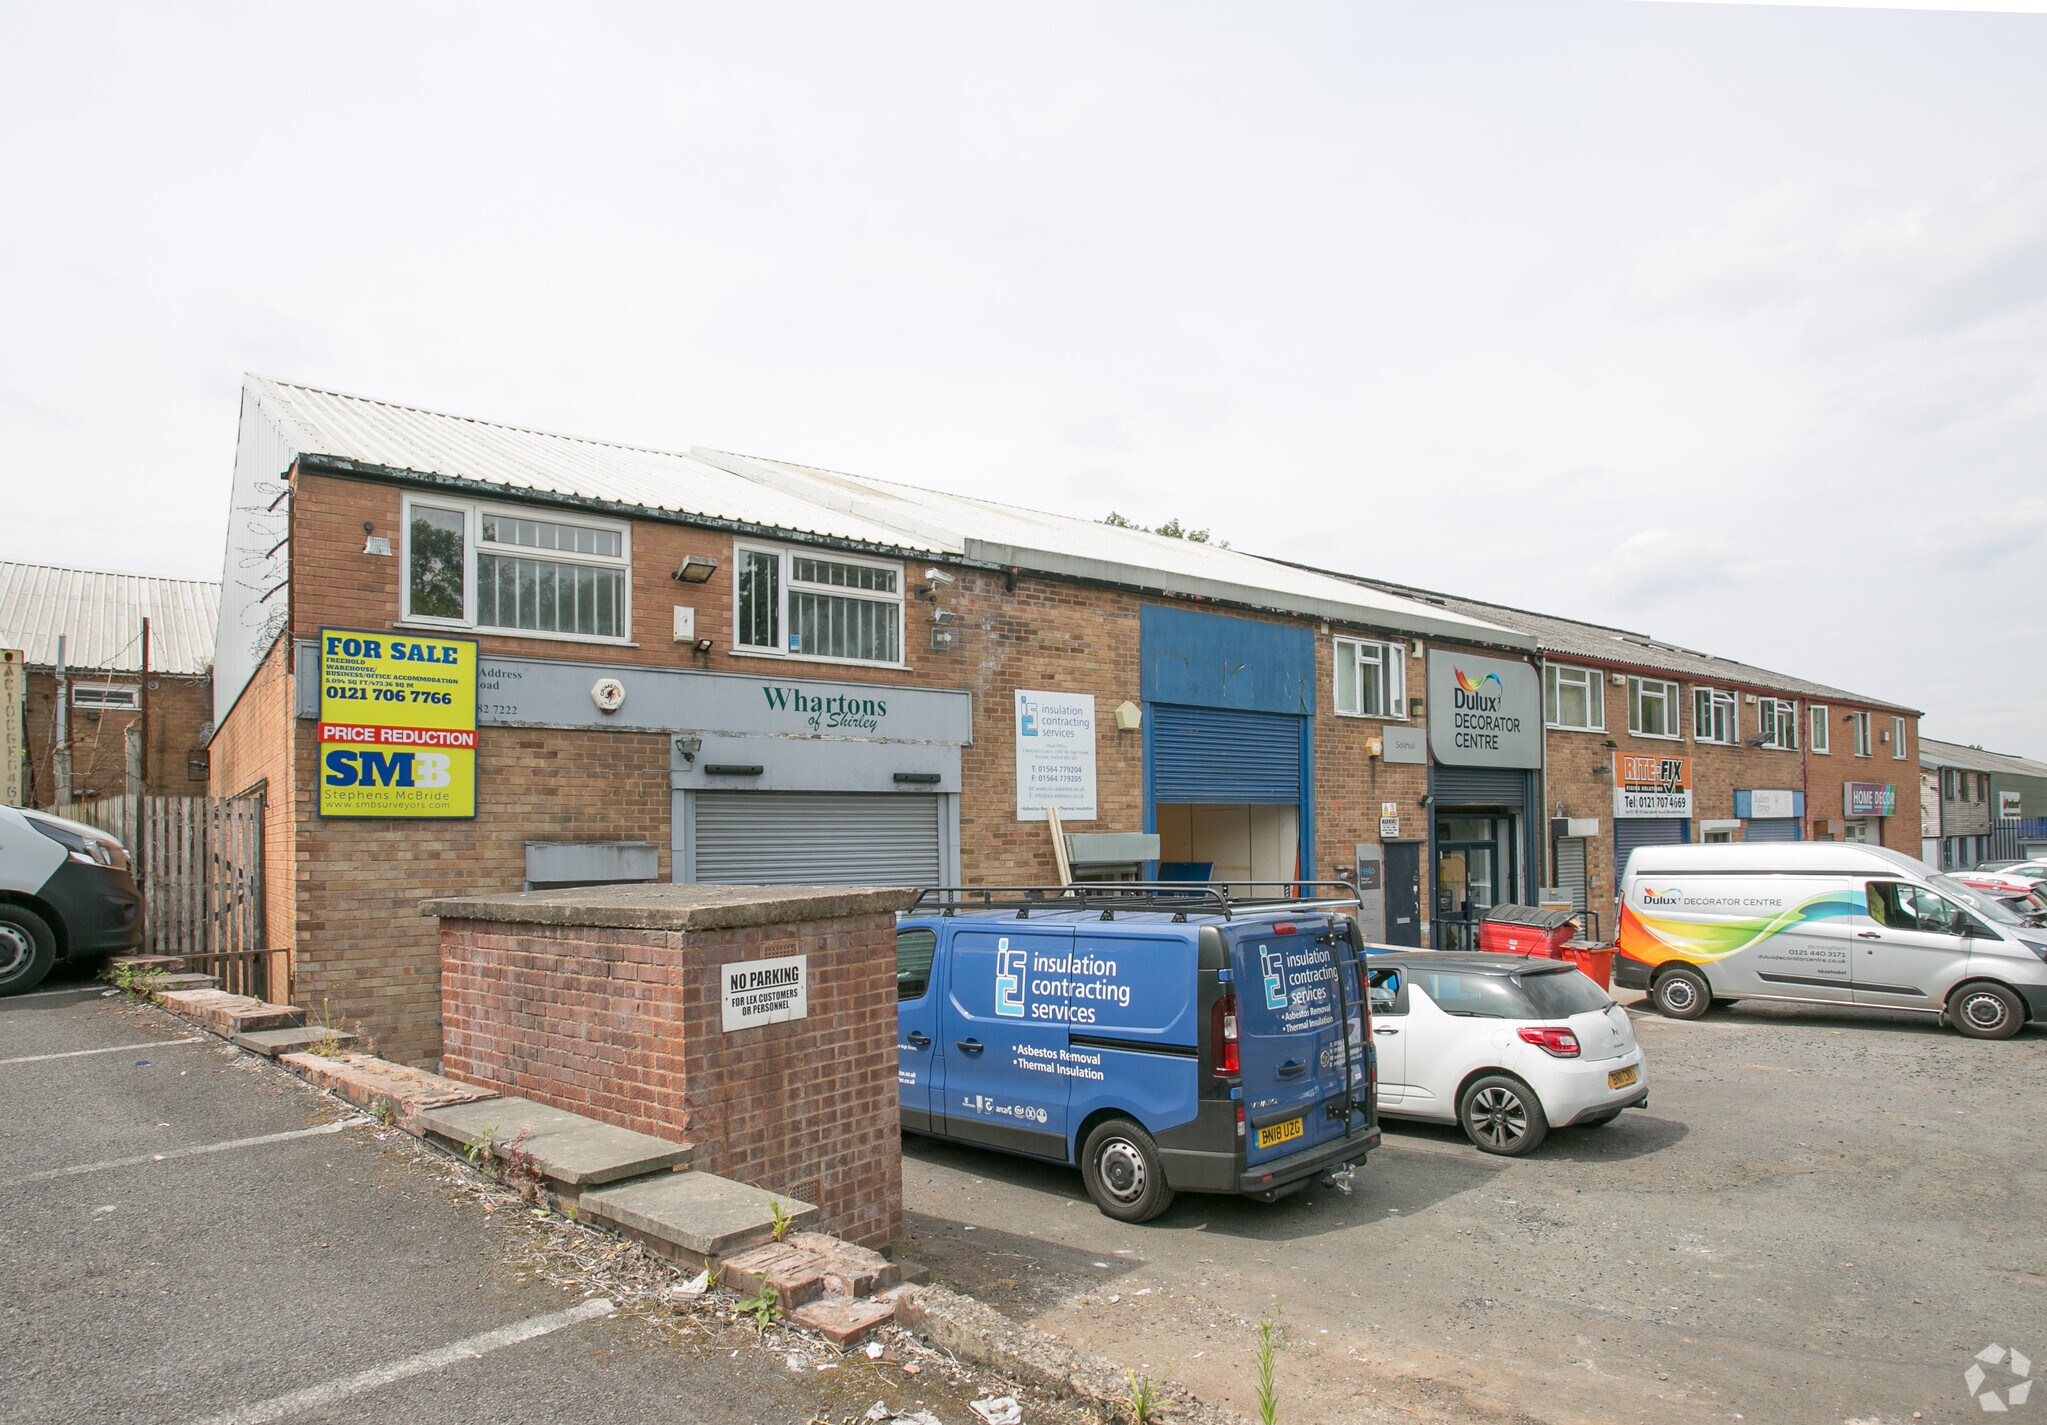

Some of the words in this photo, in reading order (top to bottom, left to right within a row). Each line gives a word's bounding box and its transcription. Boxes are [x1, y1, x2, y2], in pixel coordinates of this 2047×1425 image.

[326, 637, 382, 659] FOR
[390, 642, 458, 665] SALE
[326, 657, 365, 665] FREEHOLD
[326, 664, 377, 672] WAREHOUSE/
[326, 670, 391, 680] BUSINESS/OFFICE
[393, 675, 458, 684] ACCOMMODATION
[479, 668, 522, 679] Address
[478, 681, 500, 690] oad
[326, 686, 367, 700] 0121
[373, 688, 405, 702] 706
[410, 690, 452, 705] 7766
[762, 687, 887, 717] Whartons
[1454, 687, 1497, 712] Dulux
[493, 704, 518, 715] 7222
[1041, 704, 1083, 716] insulation
[808, 710, 823, 732] of
[826, 711, 879, 733] Shirley
[1041, 716, 1090, 729] contracting
[1454, 712, 1521, 733] DECORATOR
[323, 726, 375, 741] PRICE
[380, 728, 473, 746] REDUCTION
[1042, 728, 1075, 738] services
[1454, 732, 1499, 750] CENTRE
[325, 750, 451, 788] SMB
[1038, 765, 1058, 773] 01564
[1624, 756, 1683, 782] RITE-FIX
[1060, 775, 1082, 783] 779205
[325, 790, 389, 802] Stephens
[396, 791, 450, 801] McBride
[1624, 795, 1638, 808] Tel:
[1639, 796, 1655, 808] 0121
[1853, 790, 1873, 804] HOME
[1874, 791, 1895, 805] DECOR
[325, 801, 450, 810] www.smbsurveyors.com
[1643, 895, 1677, 905] Dulux
[1683, 897, 1741, 906] DECORATOR
[1743, 898, 1782, 907] CENTRE
[1033, 951, 1117, 976] insulation
[1285, 948, 1331, 968] insulation
[1757, 955, 1846, 964] duluxdecoratorcentre.co.uk
[731, 973, 747, 990] NO
[750, 966, 799, 988] PARKING
[1289, 964, 1339, 986] contracting
[732, 997, 745, 1007] FOR
[746, 994, 758, 1005] LEX
[759, 988, 798, 1003] CUSTOMERS
[1031, 978, 1131, 1007] contracting
[1291, 985, 1327, 1004] services
[742, 1006, 751, 1016] OR
[753, 1000, 789, 1014] PERSONNEL
[1031, 1000, 1096, 1023] services
[1285, 1008, 1309, 1021] Asbestos
[1310, 1003, 1331, 1016] Removal
[1286, 1021, 1309, 1033] Thermal
[1309, 1016, 1334, 1029] Insulation
[1017, 1044, 1057, 1059] Asbestos
[1060, 1049, 1101, 1065] Removal
[1017, 1058, 1055, 1073] Thermal
[1057, 1064, 1104, 1081] Insulation
[1261, 1126, 1282, 1144] BN18
[1283, 1120, 1300, 1137] UZG
